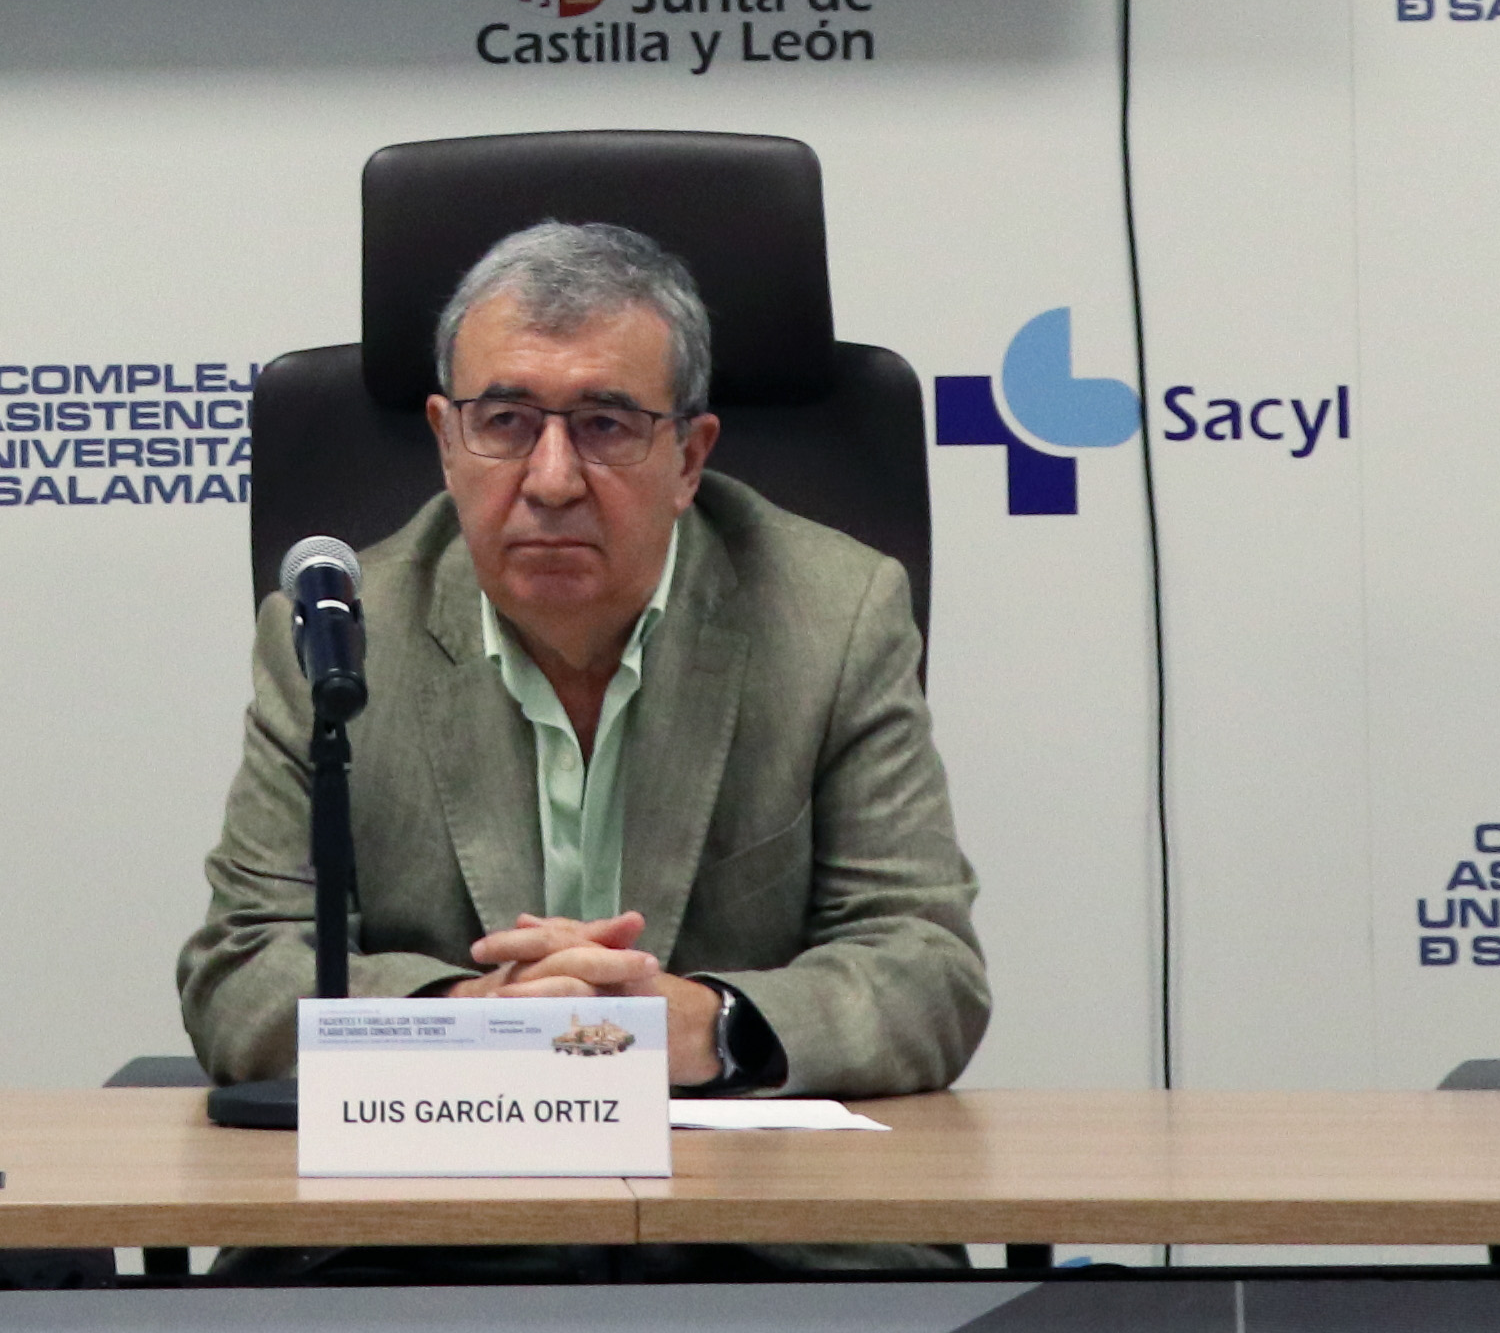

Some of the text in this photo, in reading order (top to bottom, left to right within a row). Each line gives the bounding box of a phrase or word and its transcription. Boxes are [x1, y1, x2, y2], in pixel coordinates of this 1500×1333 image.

[477, 20, 873, 75] Castilla y León
[1164, 386, 1349, 458] Sacyl
[344, 1095, 619, 1123] LUIS GARCÍA ORTIZ
